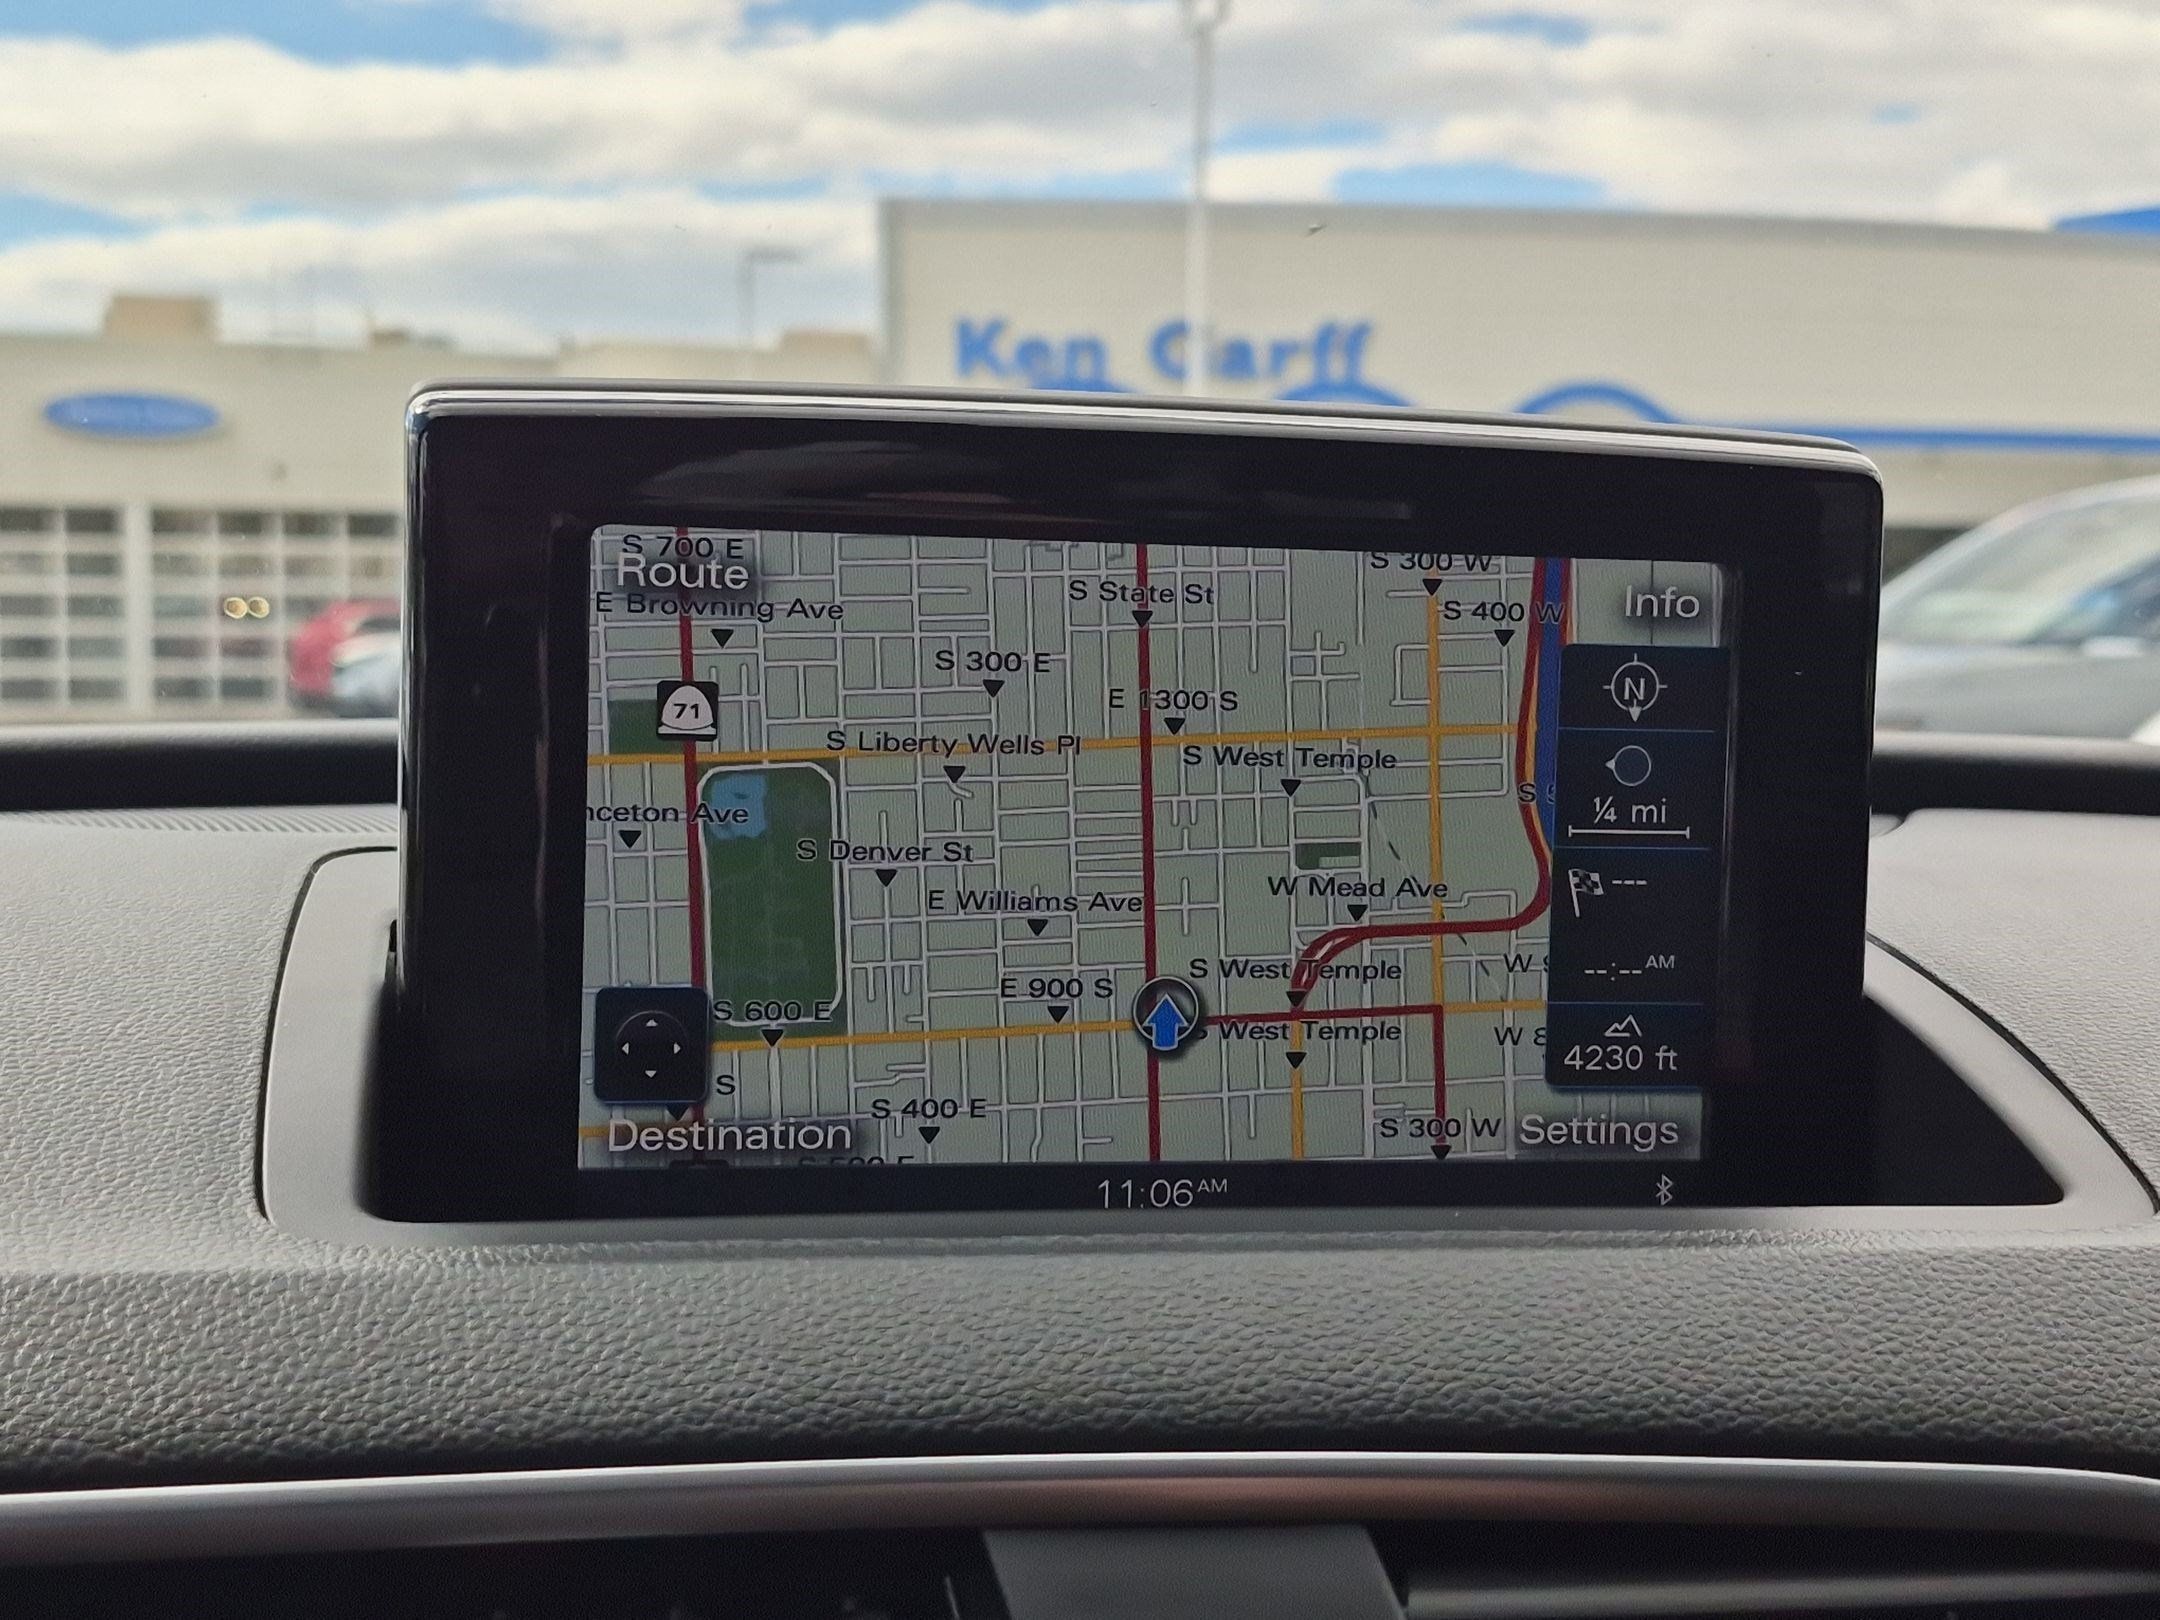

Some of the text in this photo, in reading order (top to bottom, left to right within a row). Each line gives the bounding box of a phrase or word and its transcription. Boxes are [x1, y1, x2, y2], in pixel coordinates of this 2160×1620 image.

[956, 317, 1110, 384] Ken
[623, 534, 744, 559] S 700 E
[617, 551, 749, 589] Route
[1400, 552, 1453, 571] 300
[1464, 554, 1492, 572] W
[1069, 580, 1215, 605] S State St
[1626, 585, 1700, 618] Info
[597, 592, 845, 623] E Browning Ave
[1443, 600, 1565, 624] S 400 W
[935, 650, 1051, 673] S 300 E
[673, 703, 700, 719] 71
[1109, 689, 1239, 711] E 1300 S
[826, 731, 846, 751] S
[858, 732, 958, 758] Liberty
[967, 733, 1045, 756] Wells
[1183, 745, 1397, 770] S West Temple
[690, 803, 749, 824] Ave
[1631, 797, 1667, 824] mi
[797, 839, 974, 862] S Denver St
[1268, 876, 1448, 898] W Mead Ave
[928, 890, 1143, 912] E Williams Ave
[1189, 958, 1402, 984] S West Temple
[1503, 954, 1532, 973] W
[1001, 978, 1113, 999] E 900 S
[713, 1000, 832, 1021] S 600 E
[1220, 1020, 1291, 1041] West
[1300, 1020, 1402, 1045] Temple
[1494, 1026, 1523, 1046] W
[1564, 1045, 1678, 1071] 4230 ft
[716, 1074, 736, 1096] S
[871, 1098, 987, 1120] S 400 E
[608, 1117, 851, 1151] Destination
[1380, 1118, 1501, 1138] S 300 W
[1519, 1114, 1679, 1152] Settings
